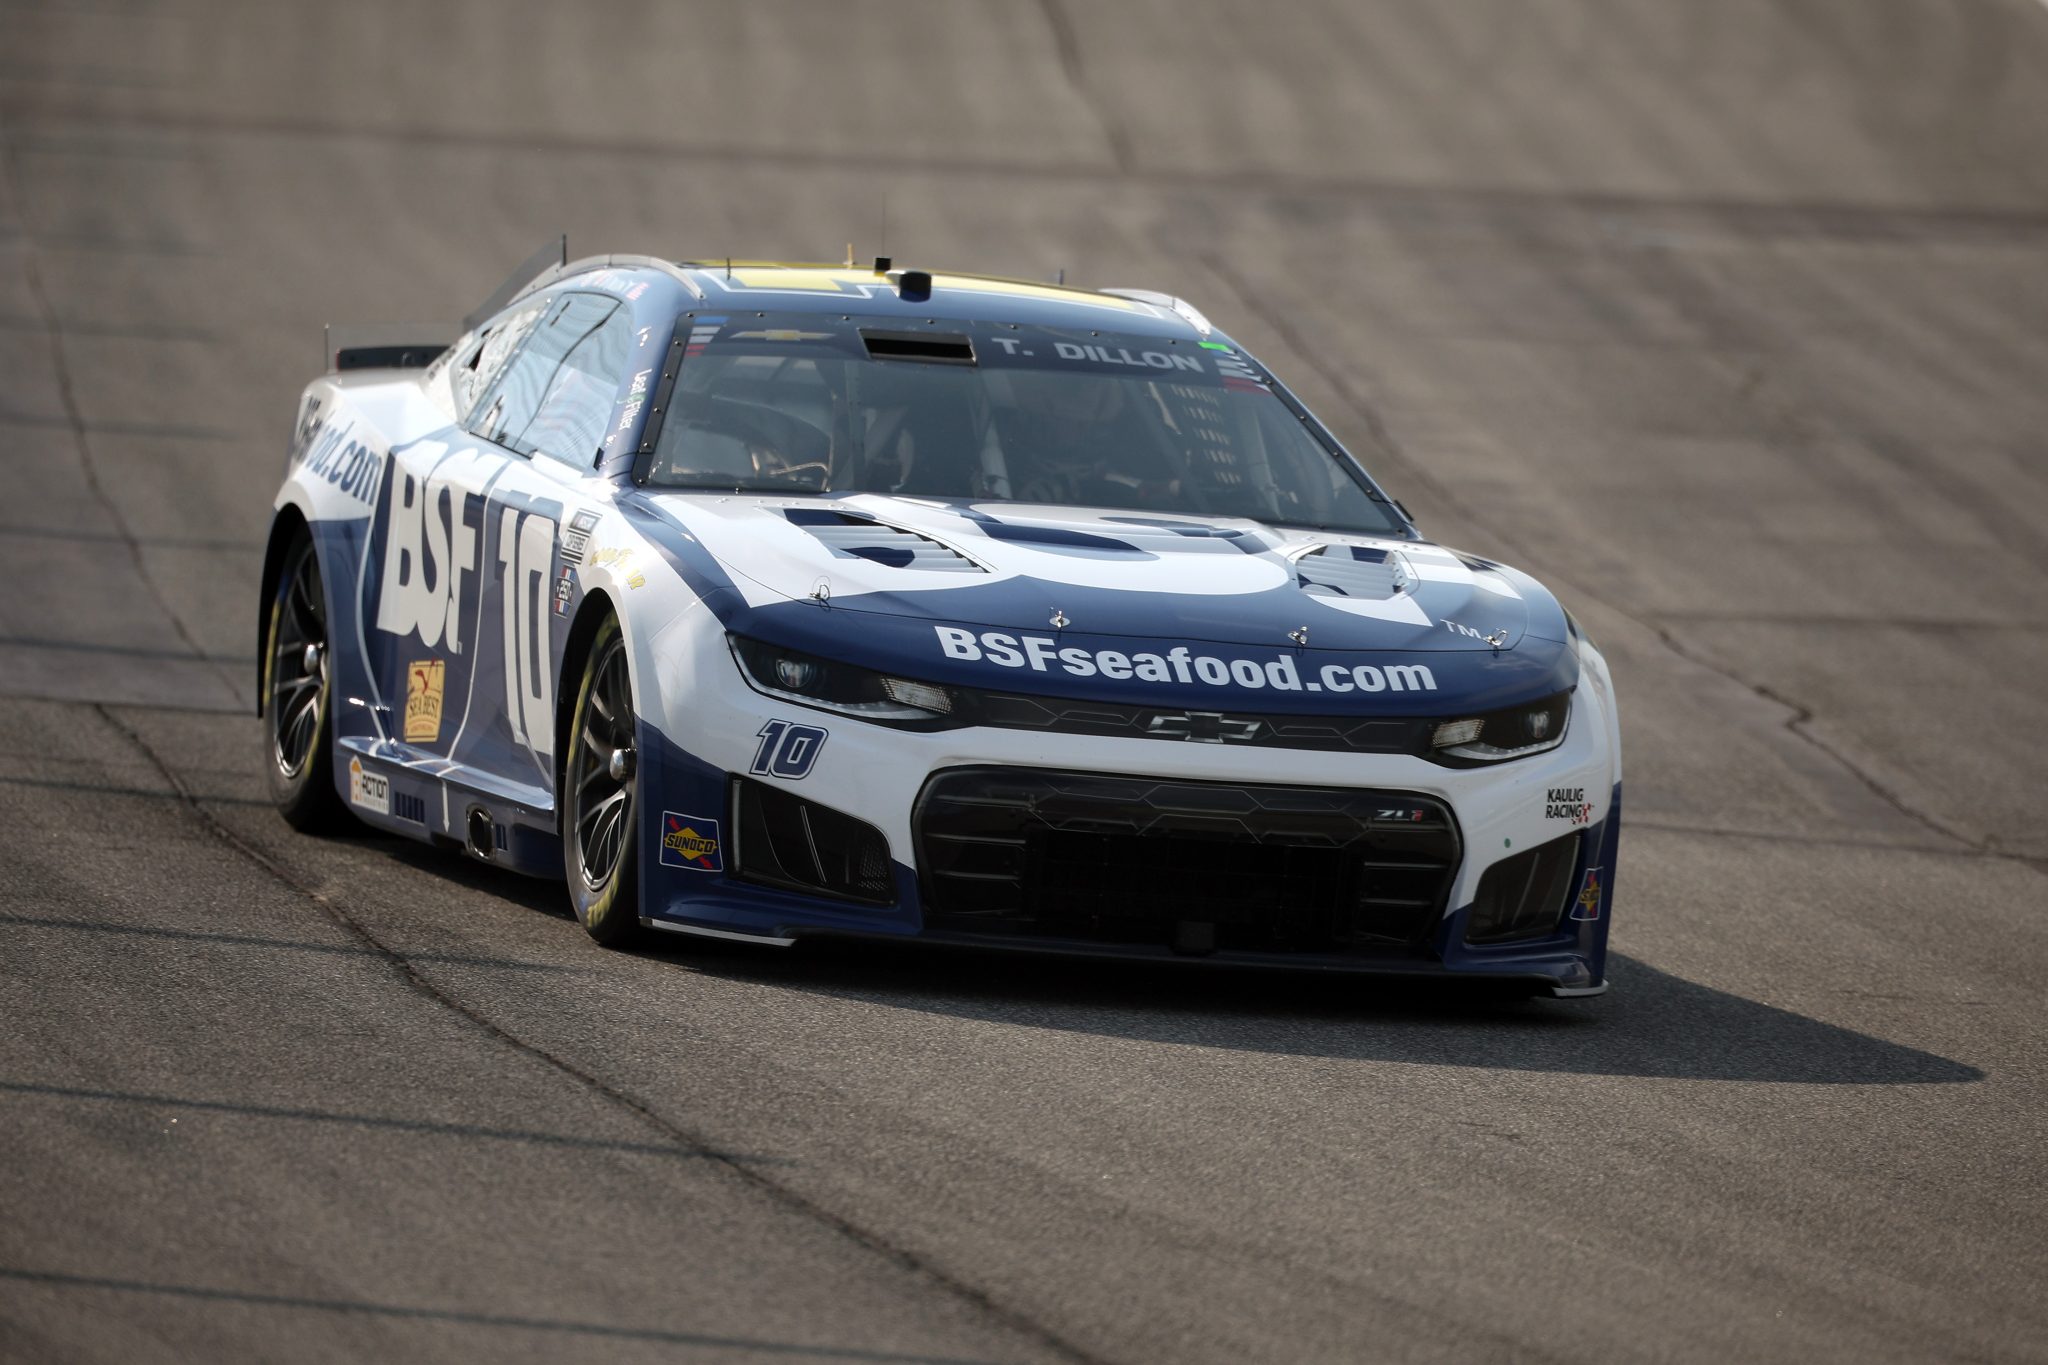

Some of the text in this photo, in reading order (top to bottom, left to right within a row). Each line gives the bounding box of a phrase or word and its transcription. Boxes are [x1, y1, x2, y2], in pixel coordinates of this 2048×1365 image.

[990, 336, 1205, 374] T. DILLON
[499, 503, 557, 757] 10
[1440, 618, 1482, 640] TM
[933, 625, 1438, 691] BSFseafood.com
[749, 718, 829, 780] 10
[1547, 788, 1584, 803] KAULIG
[1545, 803, 1582, 819] RACING
[666, 834, 715, 853] SUNOCO
